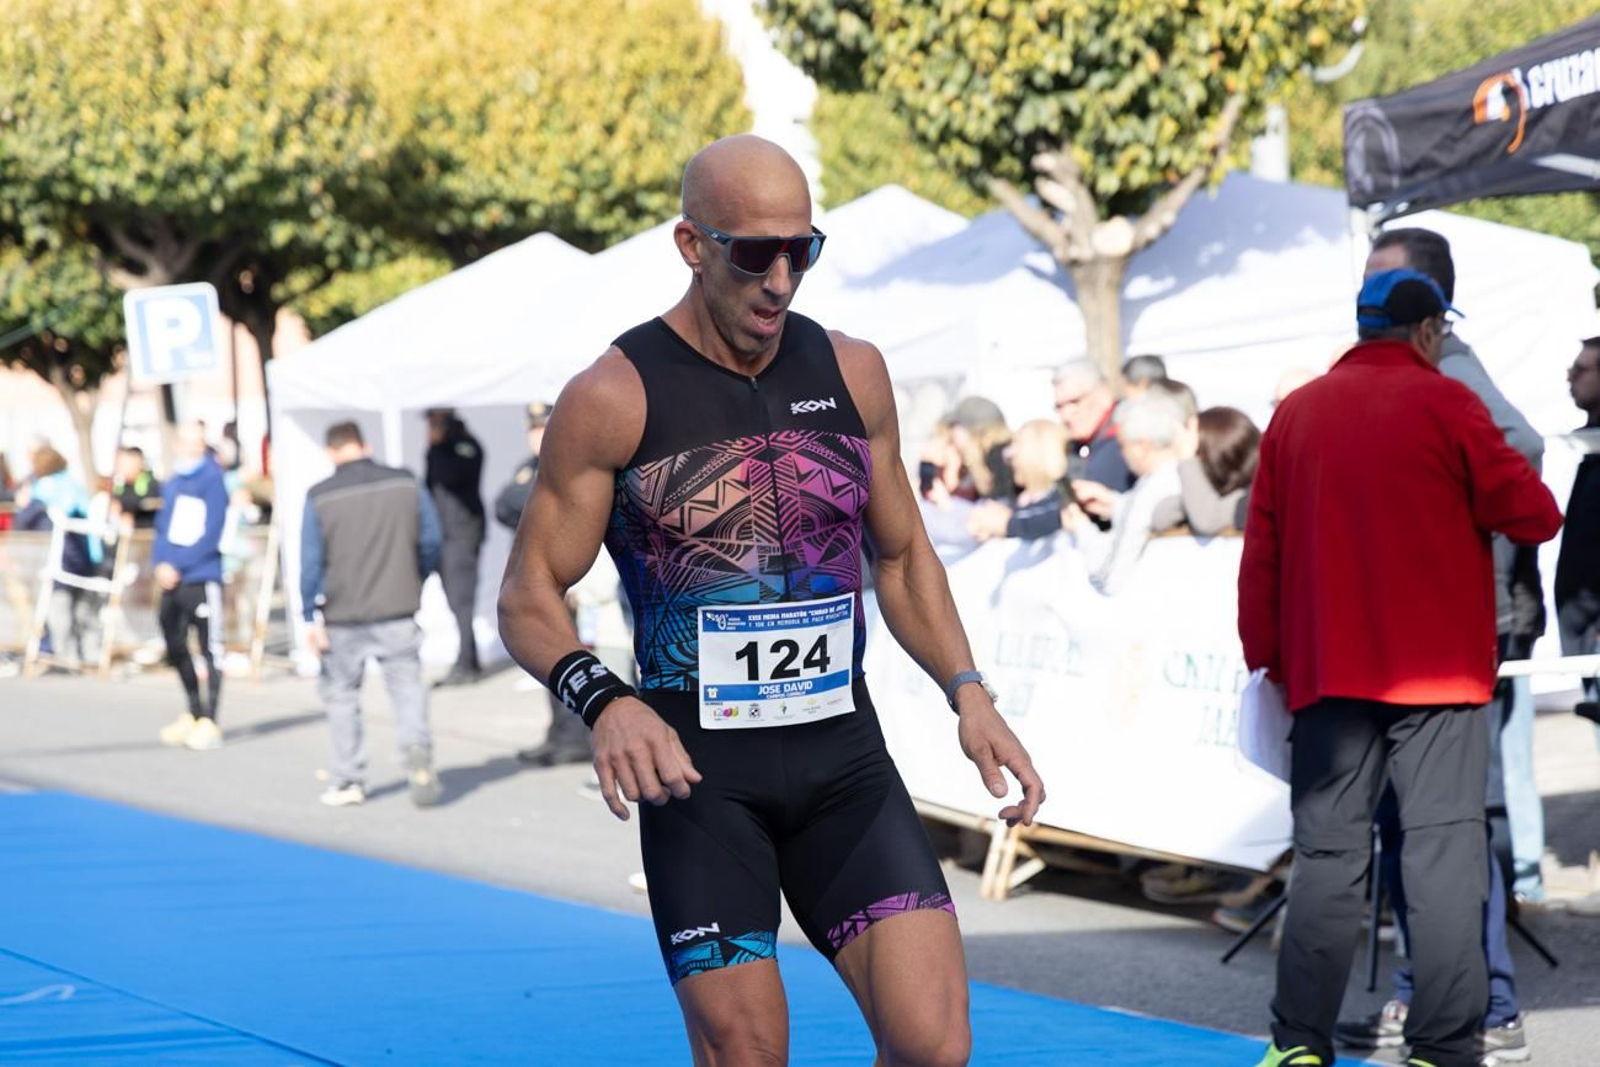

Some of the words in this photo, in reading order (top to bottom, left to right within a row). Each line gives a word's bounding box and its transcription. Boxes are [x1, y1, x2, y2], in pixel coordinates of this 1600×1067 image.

[143, 297, 203, 372] P
[735, 634, 831, 681] 124
[758, 684, 781, 696] JOSE
[784, 680, 813, 693] DAVID
